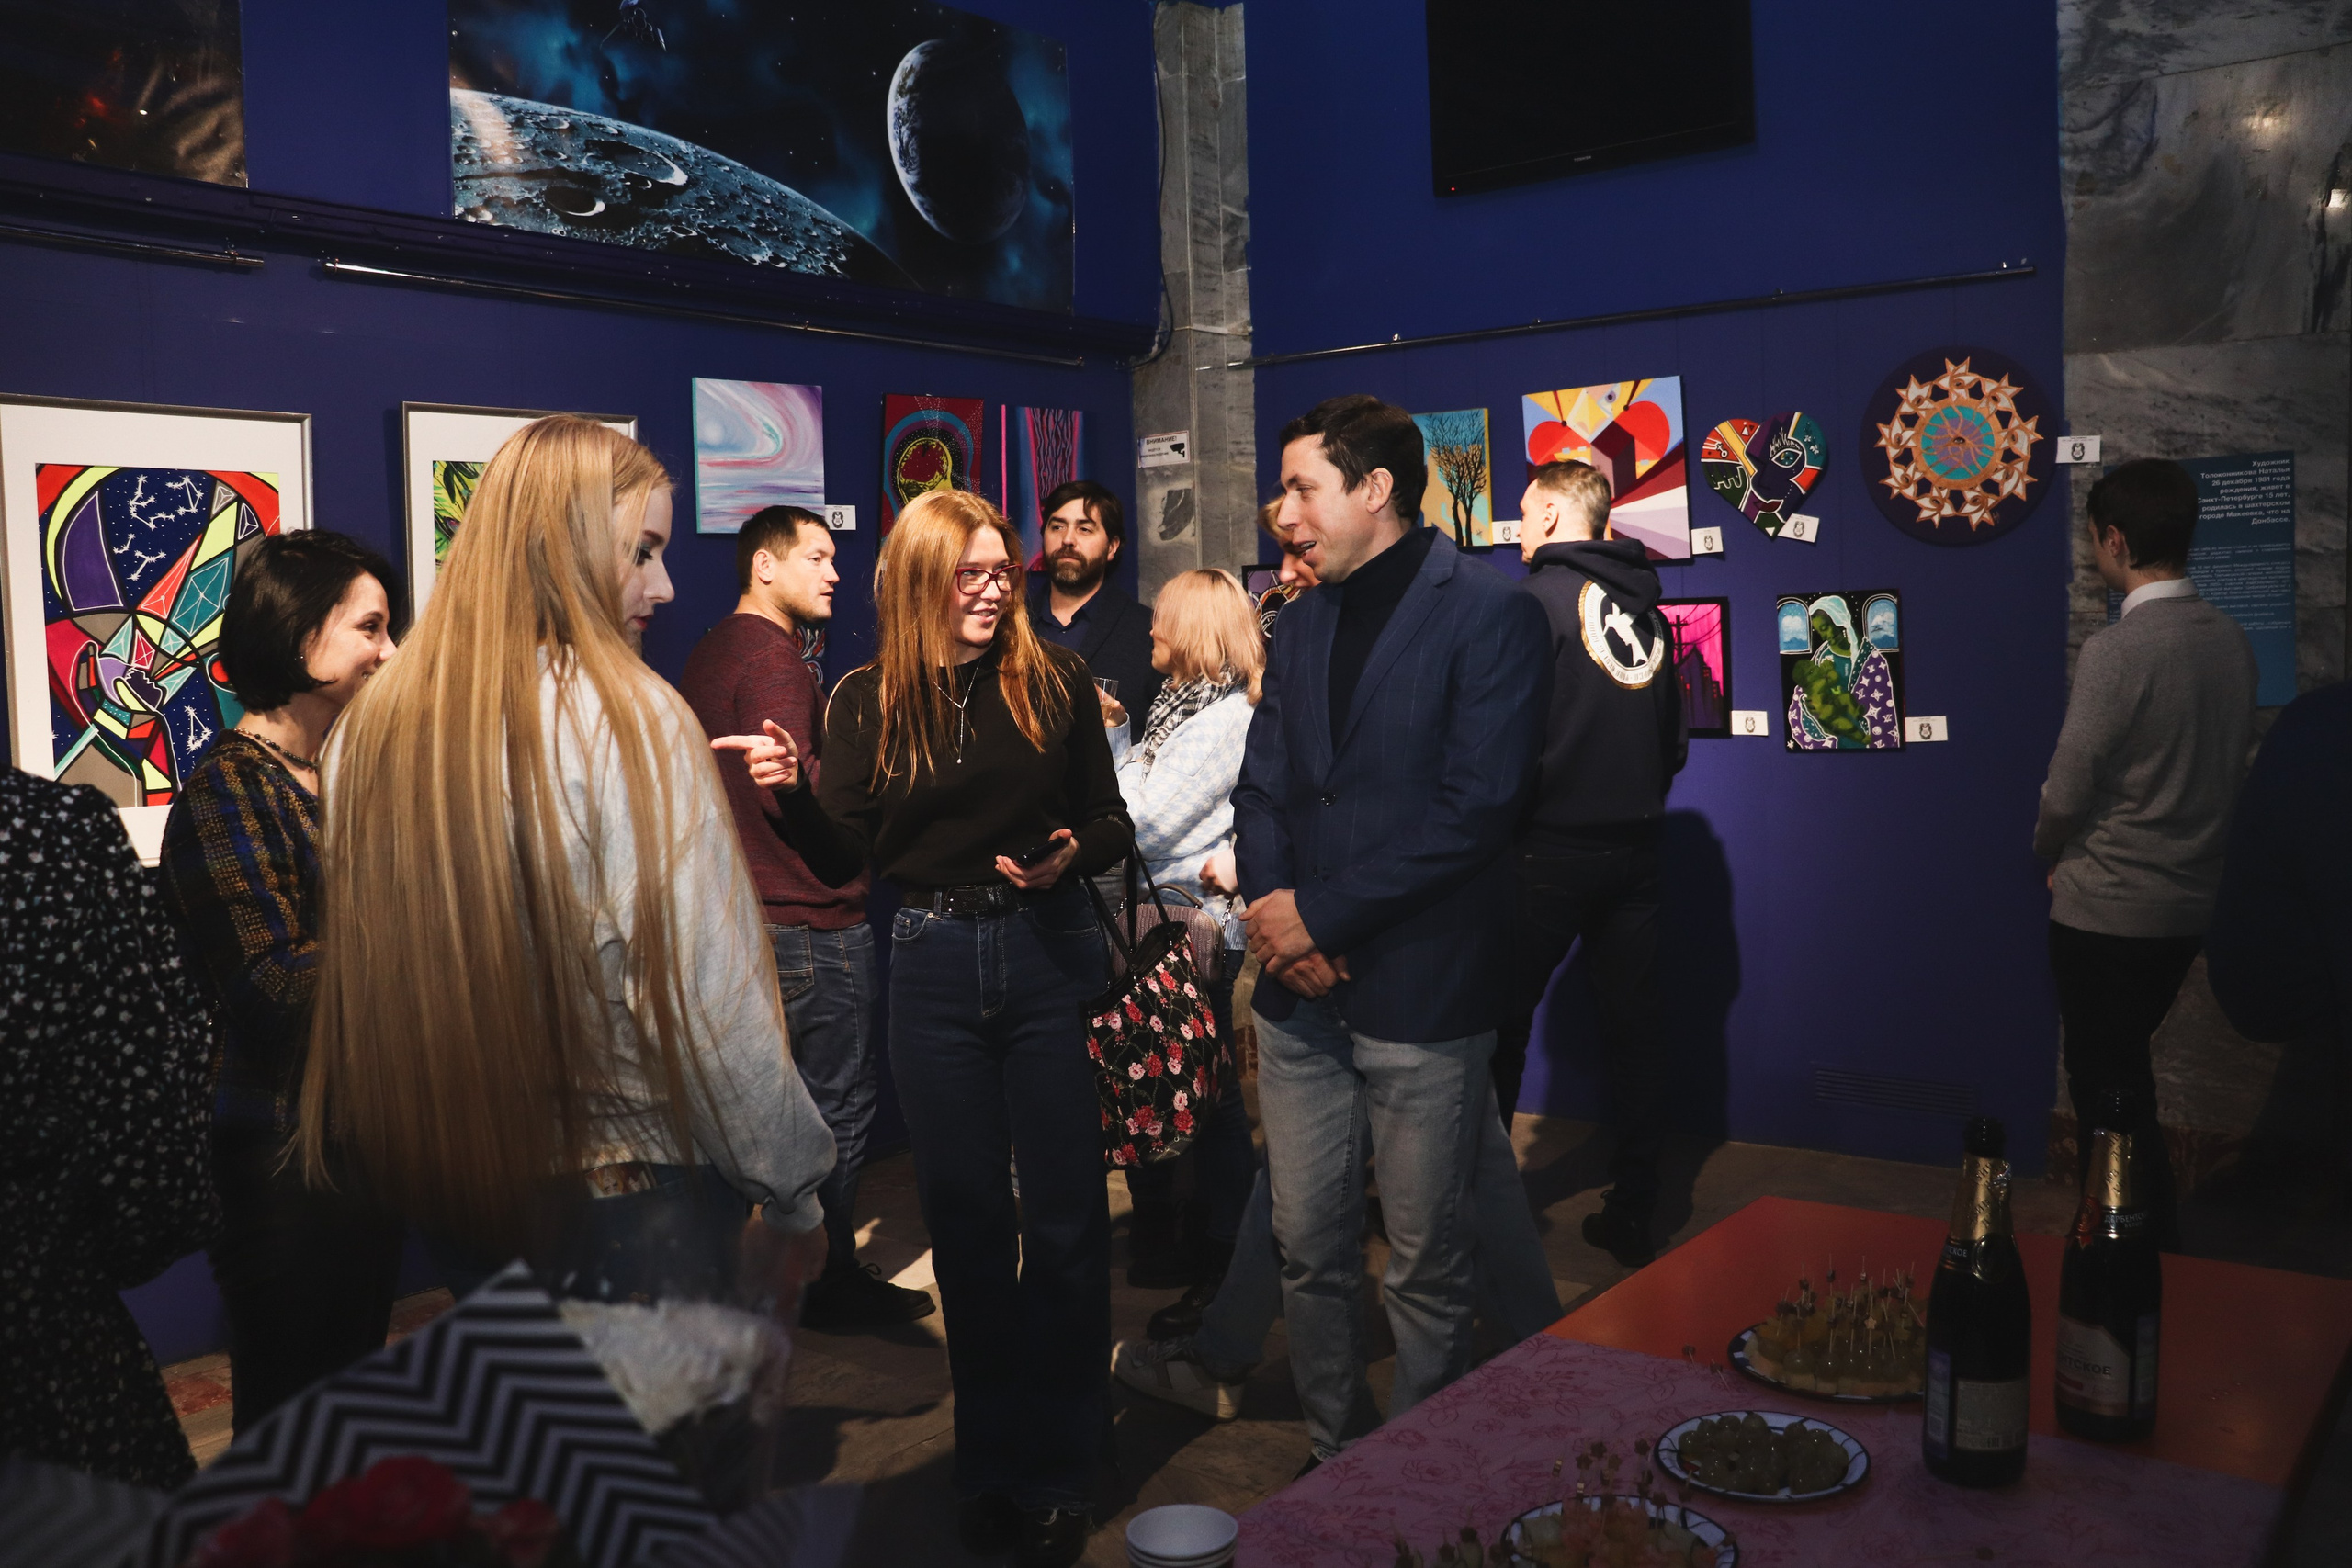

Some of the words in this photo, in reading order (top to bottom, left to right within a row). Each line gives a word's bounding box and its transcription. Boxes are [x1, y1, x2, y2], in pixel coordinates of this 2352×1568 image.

[1146, 436, 1177, 445] ВНИМАНИЕ!
[2200, 470, 2256, 479] Толоконникова
[2220, 486, 2258, 494] рождения,
[2245, 501, 2290, 509] шахтерском
[2104, 1209, 2148, 1223] ДЕРБЕНТСК
